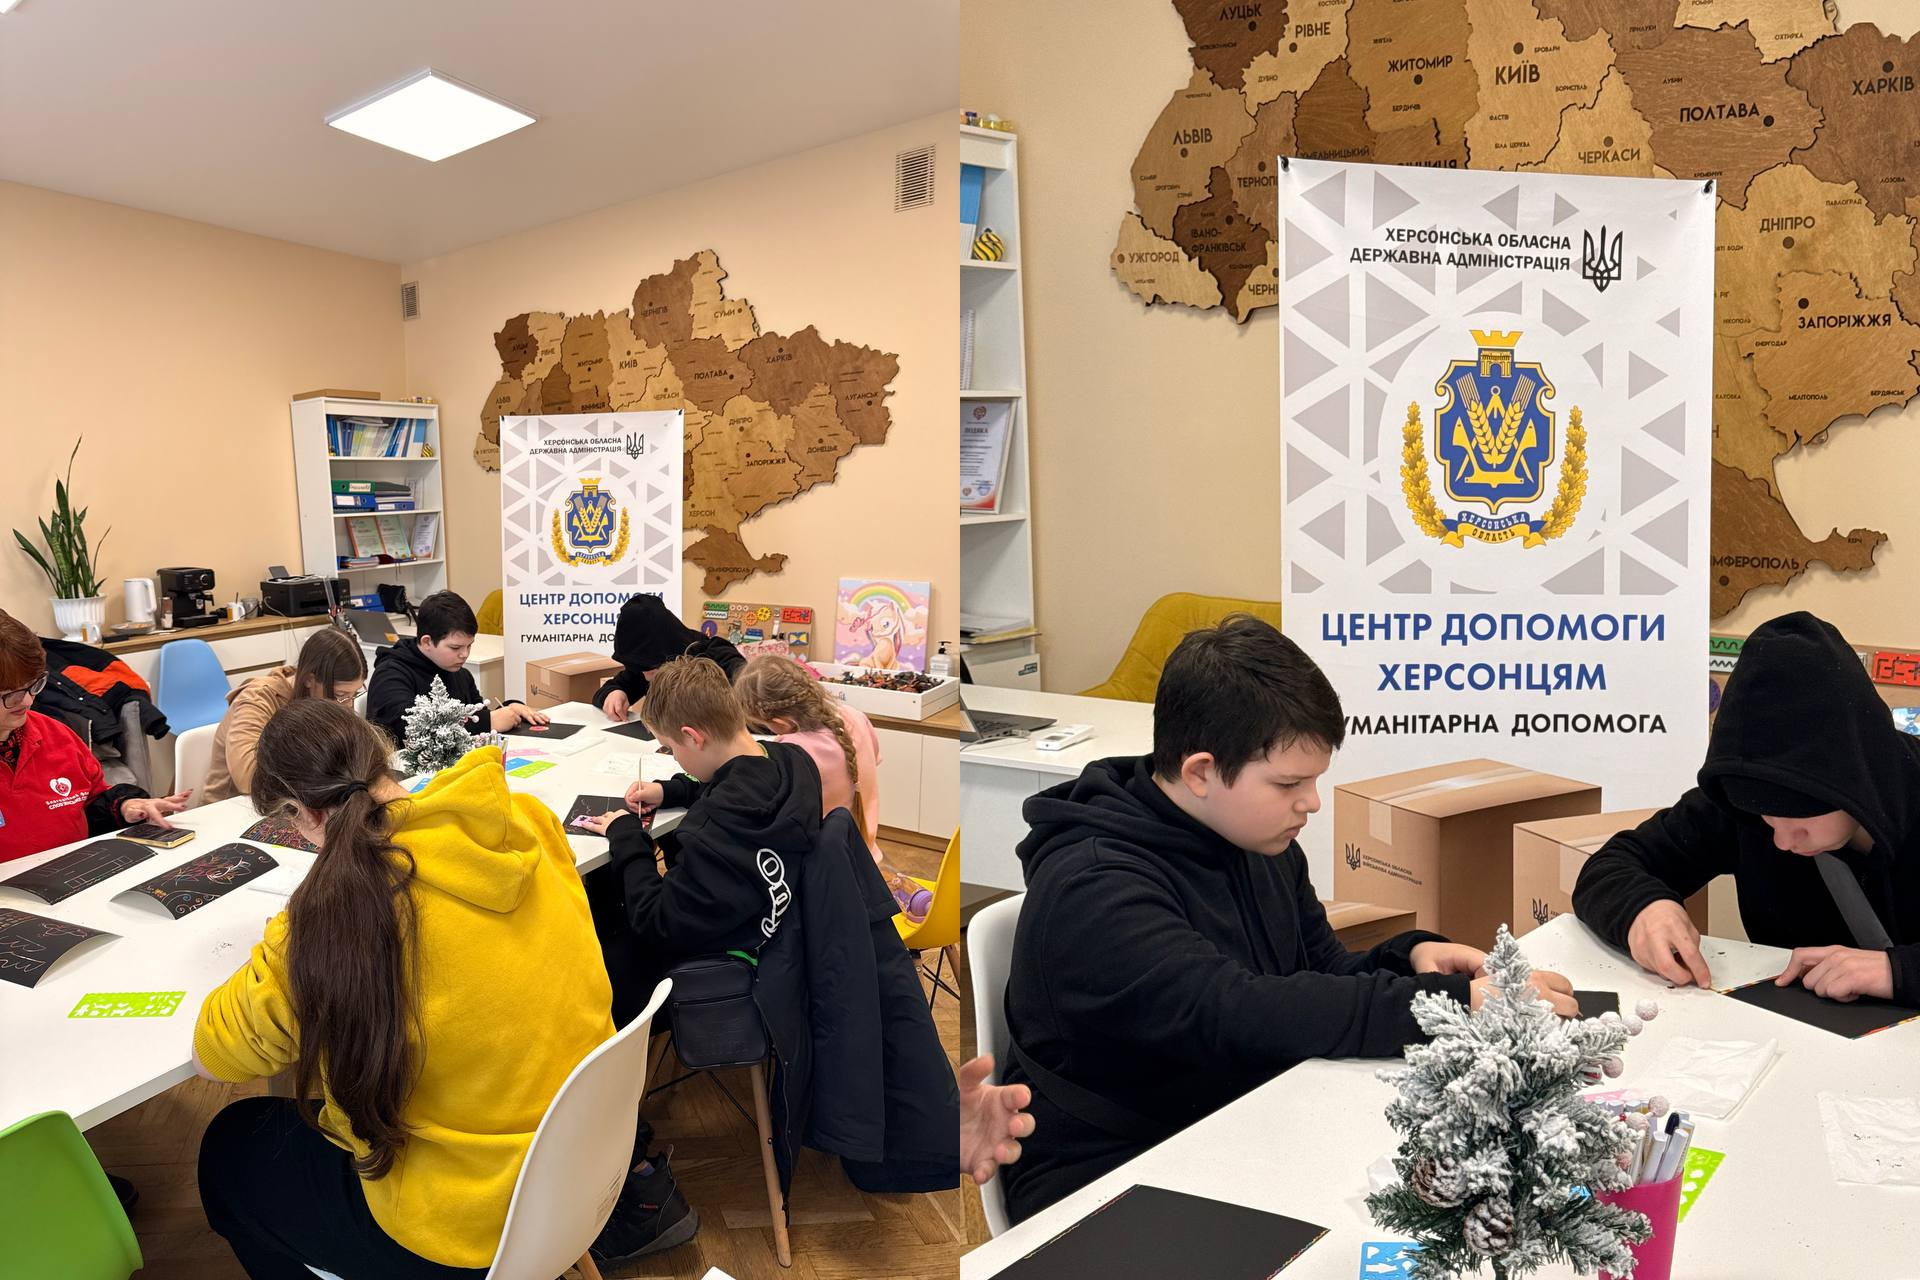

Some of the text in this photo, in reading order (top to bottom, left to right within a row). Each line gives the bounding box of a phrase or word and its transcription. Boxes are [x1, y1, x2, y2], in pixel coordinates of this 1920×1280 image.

[1219, 4, 1262, 21] ЛУЦЬК
[1295, 22, 1331, 38] РІВНЕ
[1388, 55, 1453, 73] ЖИТОМИР
[1495, 60, 1540, 86] КИЇВ
[1852, 76, 1915, 96] ХАРКІВ
[1680, 102, 1760, 123] ПОЛТАВА
[1173, 128, 1213, 145] ЛЬВІВ
[1578, 148, 1641, 165] ЧЕРКАСИ
[1759, 216, 1816, 234] ДНІПРО
[1385, 228, 1572, 250] ХЕРСОНСЬКА ОБЛАСНА
[1128, 251, 1180, 264] УЖГОРОД
[1350, 248, 1570, 272] ДЕРЖАВНА АДМІНІСТРАЦІЯ
[1248, 284, 1279, 296] ЧЕРНІ
[1798, 314, 1892, 329] ЗАПОРІЖЖЯ
[694, 370, 728, 380] ПОЛТАВА
[544, 437, 622, 446] ХЕРСОНСЬКА ОБЛАСНА
[530, 446, 622, 455] ДЕРЖАВНА АДМІНІСТРАЦІЯ
[1461, 512, 1526, 530] ХЕРСОНСЬКА
[1472, 528, 1516, 542] ОБЛАСТЬ
[1712, 555, 1800, 569] МФЕРОПОЛЬ
[520, 592, 664, 608] ЦЕНТР ДОПОМ
[544, 613, 620, 626] ХЕРСОНЦ
[1322, 613, 1666, 646] ЦЕНТР ДОПОМОГИ
[521, 634, 594, 643] ГУМАНІТАРНА
[1377, 663, 1606, 696] ХЕРСОНЦЯМ
[1344, 714, 1667, 737] МАНІТАРНА ДОПОМОГА
